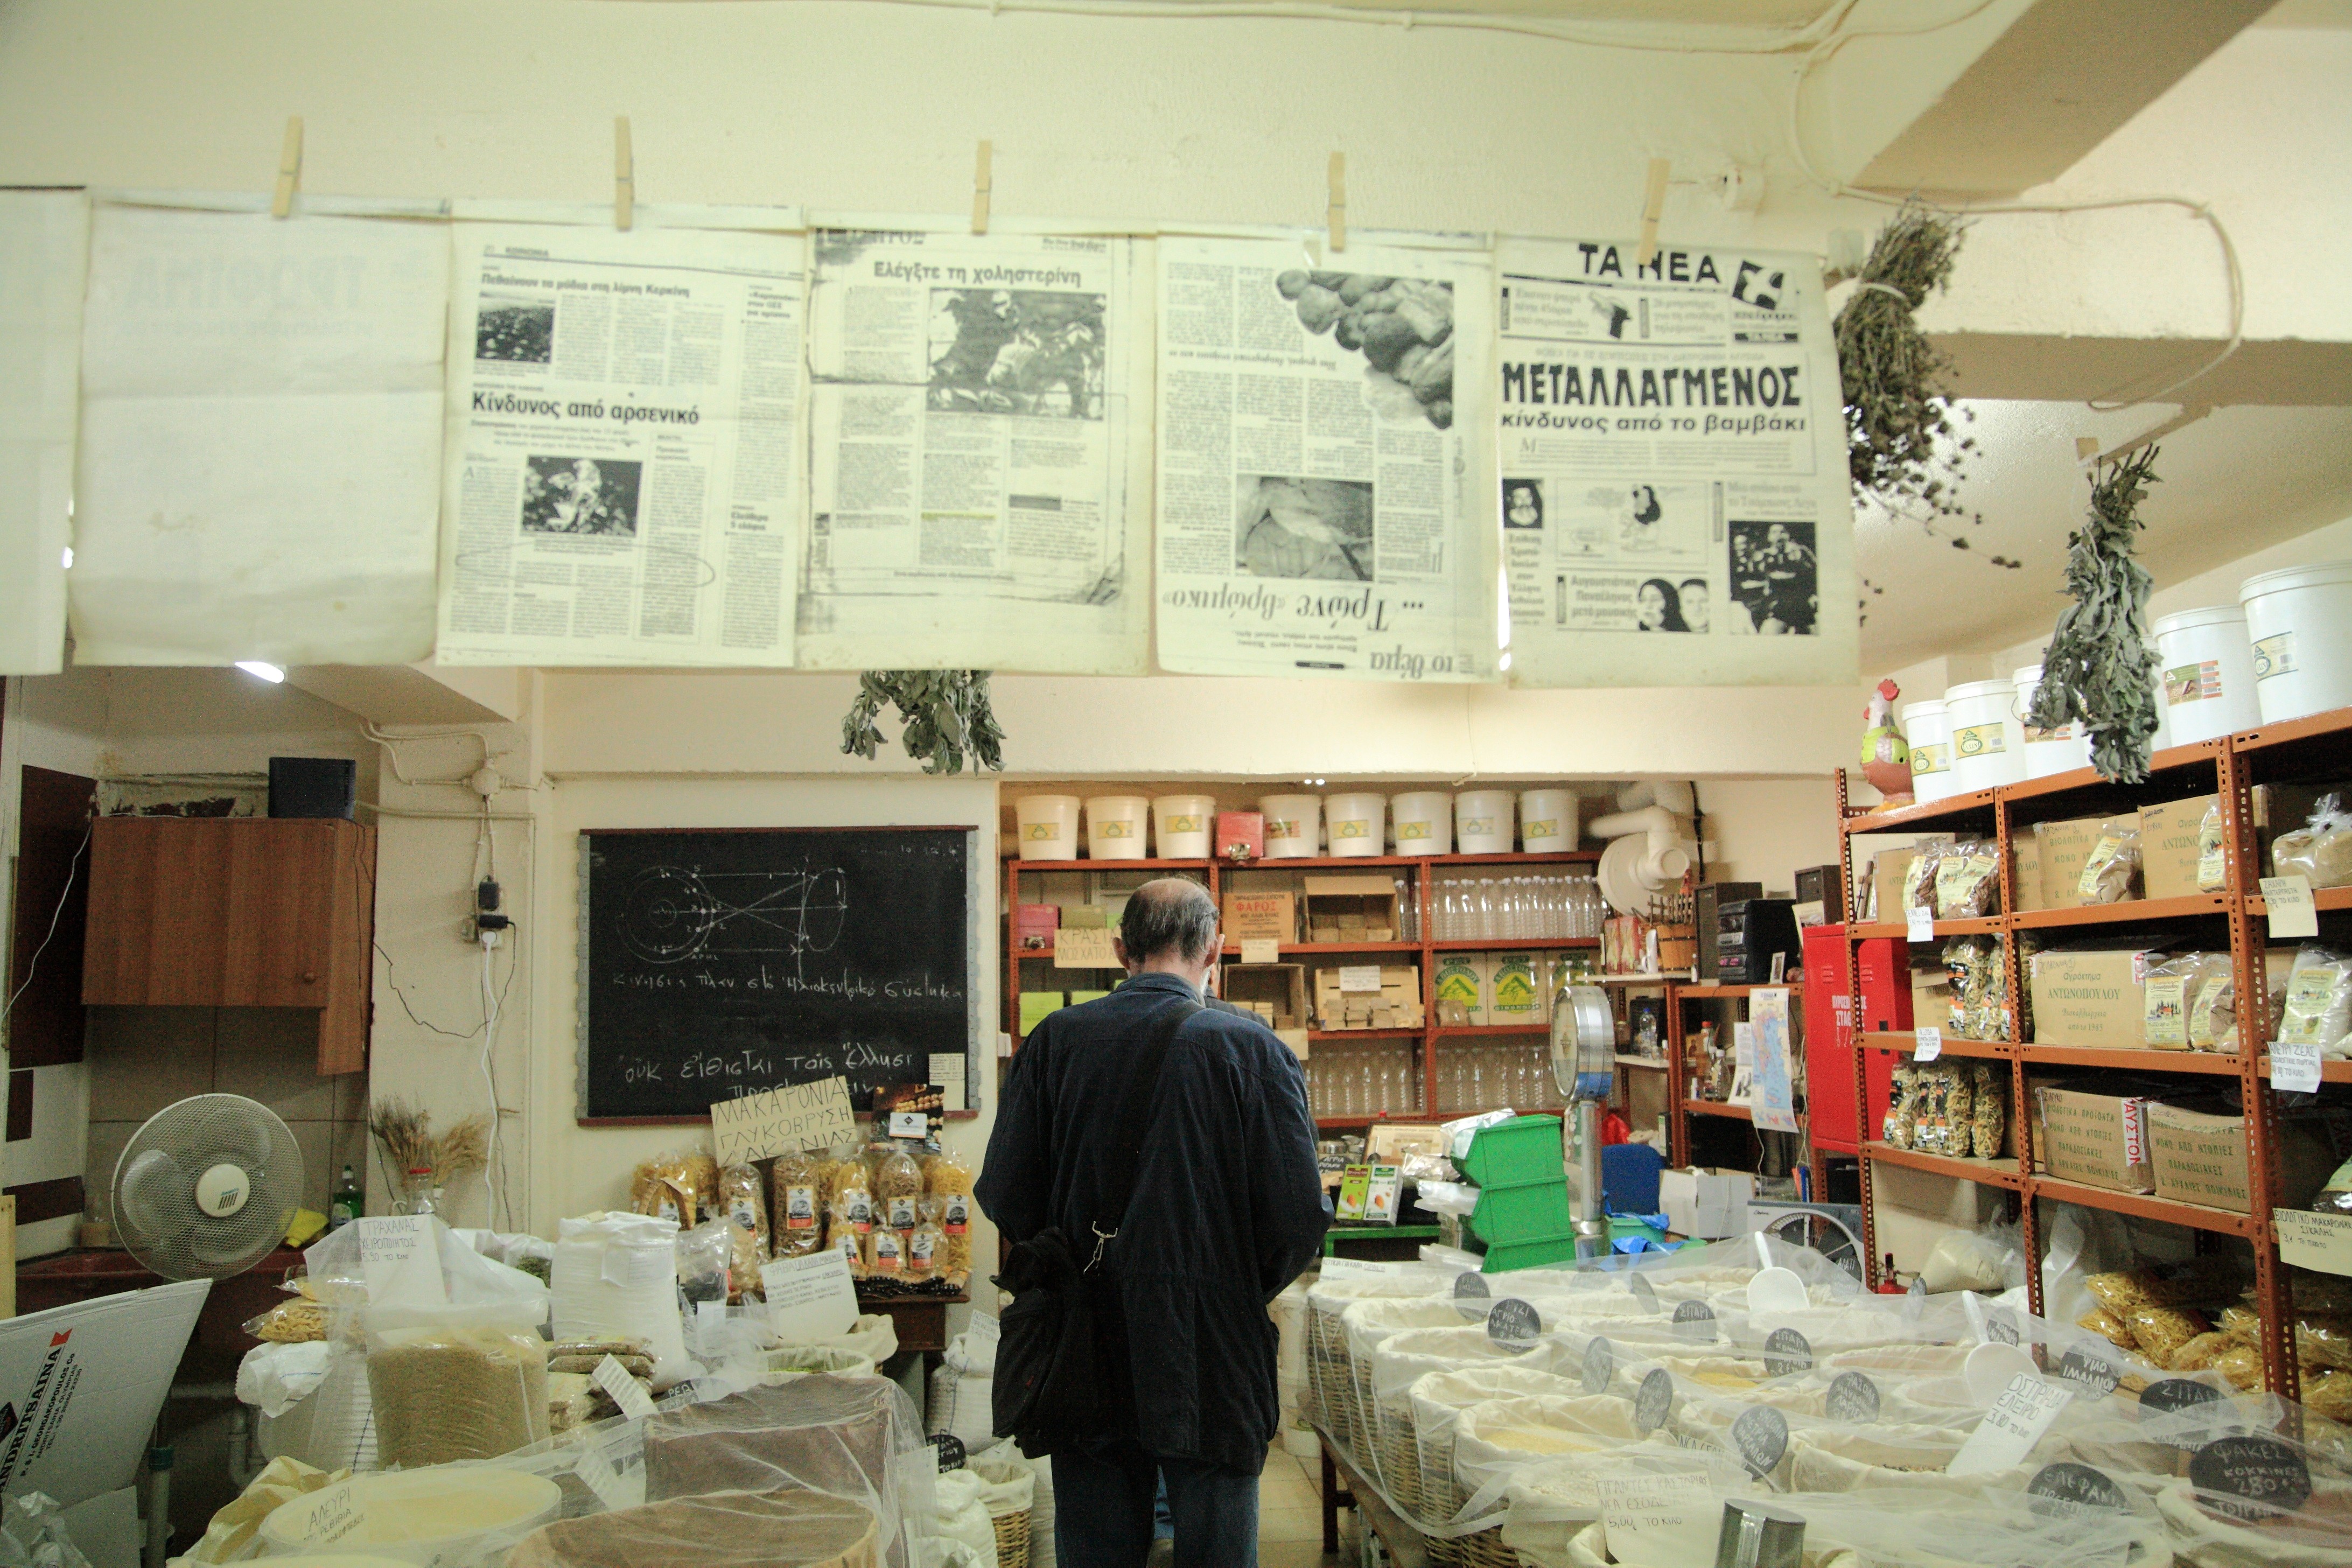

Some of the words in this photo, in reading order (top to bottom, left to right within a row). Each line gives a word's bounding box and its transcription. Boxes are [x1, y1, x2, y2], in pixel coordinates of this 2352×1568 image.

[1579, 243, 1623, 277] ΤΑ
[1639, 251, 1720, 284] ΝΕΑ
[874, 261, 940, 282] Ελέγξτε
[948, 268, 967, 283] τη
[973, 265, 1082, 288] χοληστερίνη
[1501, 361, 1801, 407] ΜΕΤΑΛΛΑΓΜΕΝΟΣ
[472, 391, 560, 419] Κίνδυνος
[568, 398, 604, 418] από
[612, 404, 699, 424] αρσενικό
[1501, 411, 1608, 433] κίνδυνος
[1616, 412, 1662, 431] από
[1670, 417, 1695, 430] το
[1704, 414, 1805, 435] βαμβάκι
[1370, 644, 1425, 680] θέμα
[2050, 835, 2089, 846] ΒΙΟΛΟΓΙΚΑ
[2055, 855, 2076, 864] ΜΟΝΟ
[1236, 901, 1277, 911] ΦΑΡΟΣ
[1057, 947, 1107, 961] ΜΟΣΧΑΤΟ
[2048, 988, 2120, 1000] ΑΝΤΩΝΟΠΟΥΛΟΥ
[2088, 1023, 2103, 1032] 1985
[715, 1079, 848, 1125] ΜΑΚΑΡΟΝΙΑ
[2047, 1104, 2077, 1117] ΒΙΟΛΟΓΙΚΑ
[720, 1105, 850, 1148] ΓΛΥΚΟΒΡΥΣΗ
[2049, 1122, 2067, 1134] ΜΟΝΟ
[2069, 1126, 2081, 1137] ΑΠΟ
[2086, 1129, 2112, 1141] ΝΤΟΠΙΕΣ
[2057, 1142, 2103, 1159] ΠΑΡΑΔΟΣΙΑΚΕΣ
[2156, 1137, 2174, 1150] ΜΟΝΟ
[2178, 1141, 2193, 1153] ΑΠΟ
[2198, 1144, 2234, 1157] ΝΤΟΠΙΕΣ
[2169, 1159, 2223, 1176] ΠΑΡΑΔΟΣΙΑΚΕΣ
[363, 1218, 420, 1236] ΤΡΑΧΑΝΑΣ
[2301, 1226, 2335, 1238] ΣΙΚΑΛΗΣ
[360, 1237, 417, 1250] ΧΕΙΡΟΠΟΙΗΤΟΣ
[1680, 1305, 1708, 1319] ΣΙΤΑΡΙ
[2083, 1355, 2108, 1373] ΨΙΛΟ
[1597, 1479, 1651, 1496] ΓΙΓΑΝΤΕΣ
[1656, 1476, 1709, 1490] ΚΑΣΤΟΡΙΑΣ
[308, 1487, 351, 1532] ΑΛΕΥΡΙ
[1600, 1499, 1620, 1511] ΝΕΑ
[320, 1508, 352, 1536] ΡΕΒΙΘΙΑ
[1646, 1517, 1659, 1527] ΤΟ
[1662, 1517, 1683, 1526] ΚΙΛΟ
